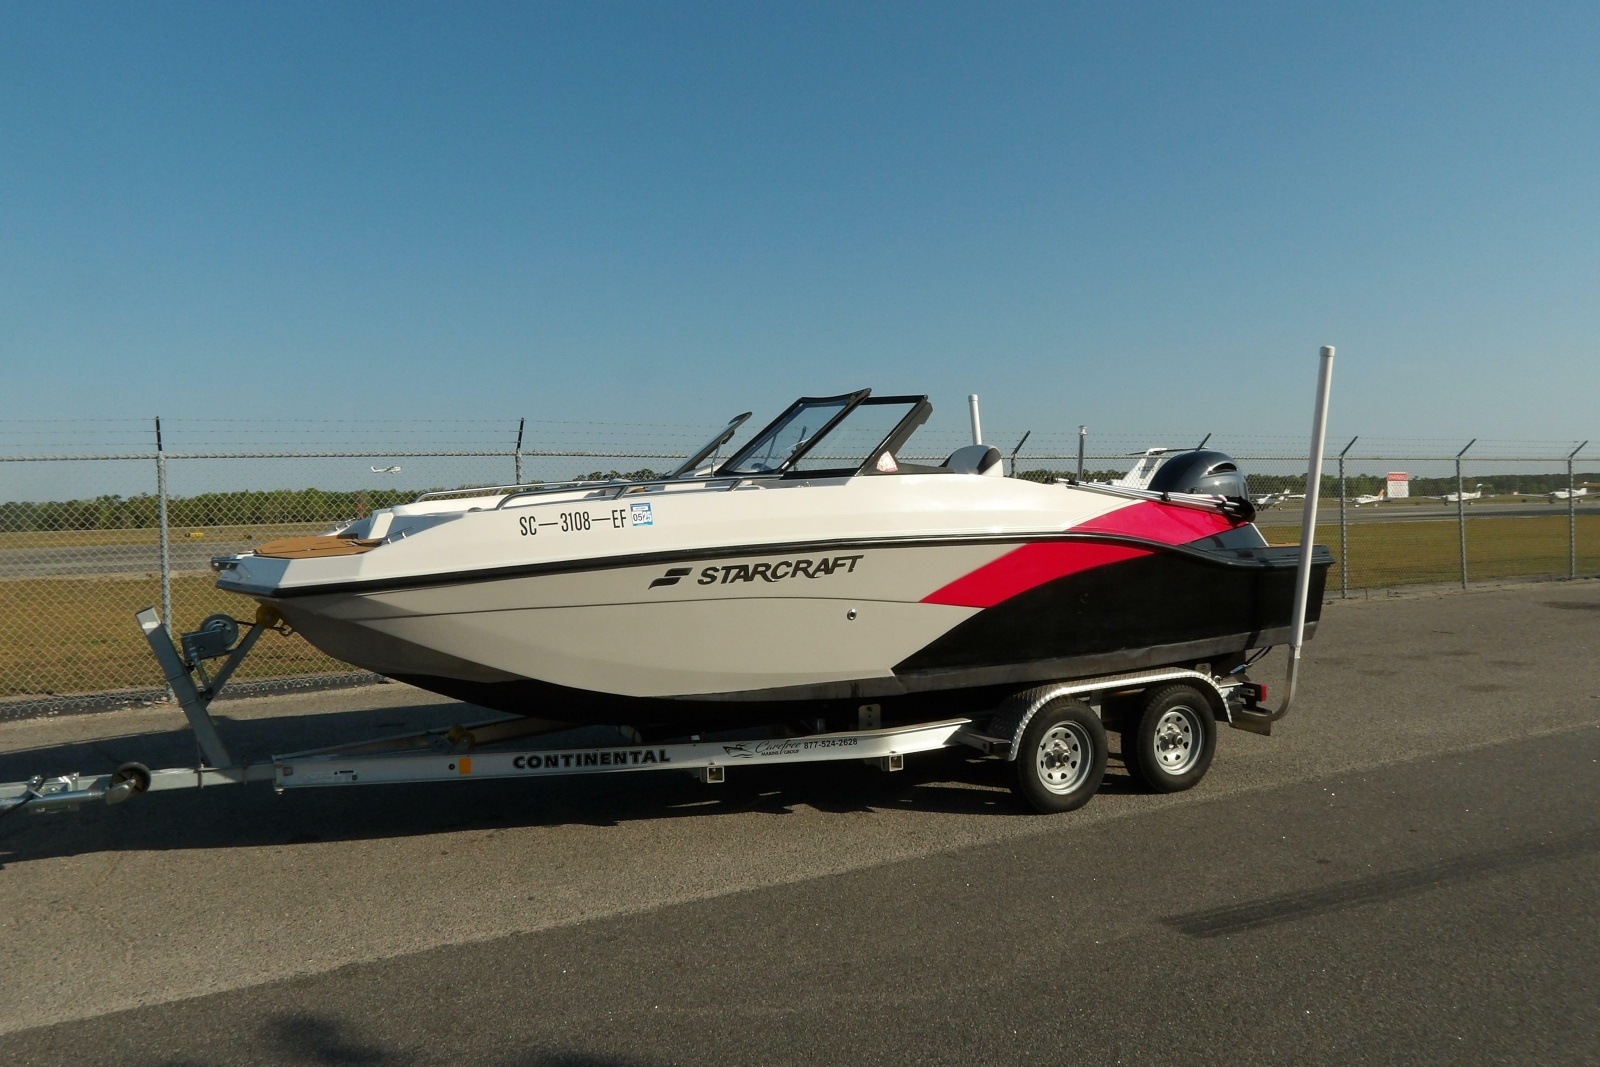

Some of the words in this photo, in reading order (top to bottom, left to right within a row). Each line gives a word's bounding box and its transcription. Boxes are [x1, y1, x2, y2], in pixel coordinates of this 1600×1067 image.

[697, 555, 864, 586] STARCRAFT
[755, 740, 801, 755] Carefree
[804, 738, 858, 749] 877-524-2628
[513, 749, 671, 769] CONTINENTAL
